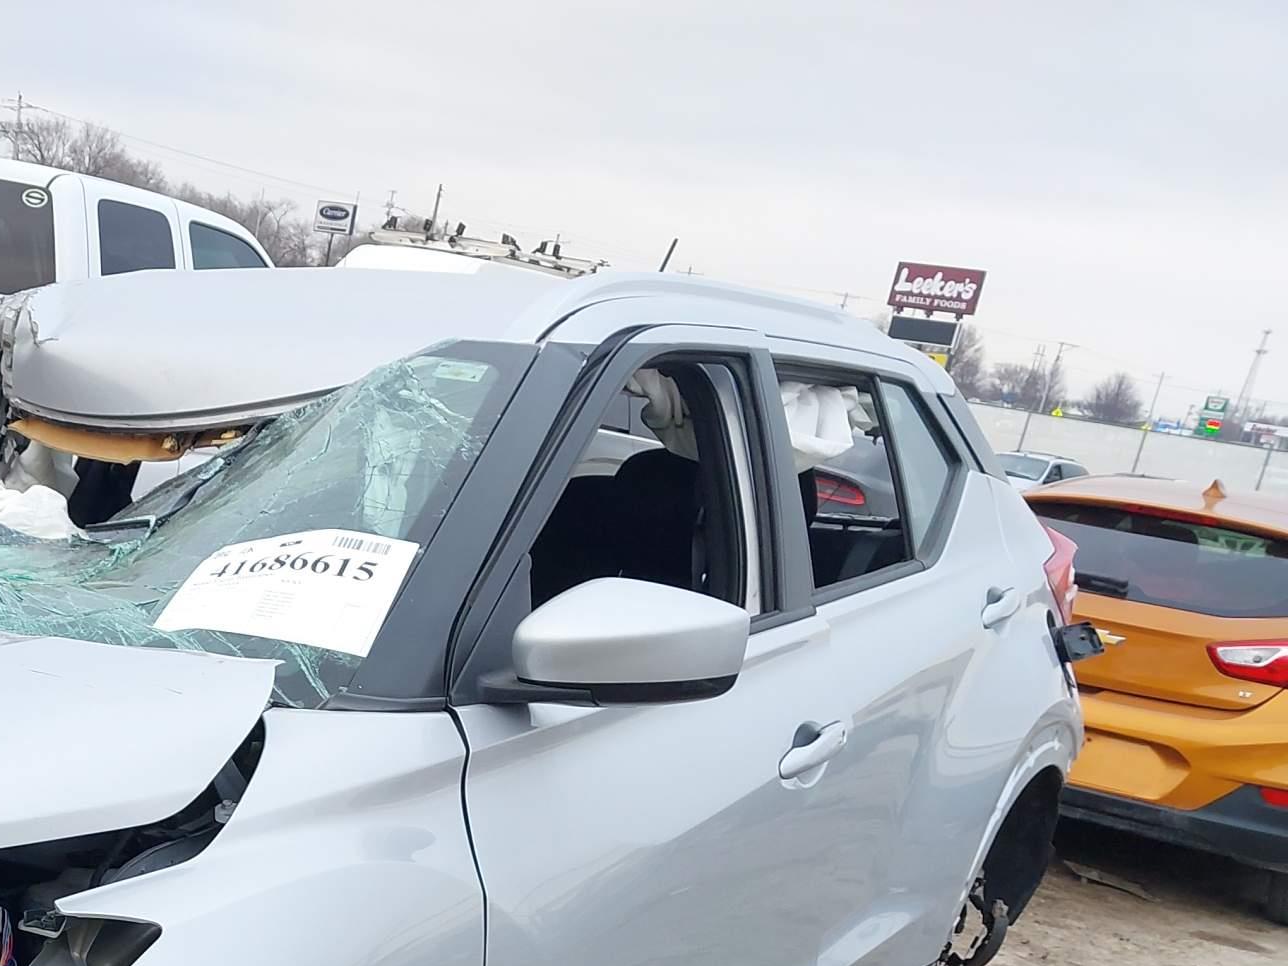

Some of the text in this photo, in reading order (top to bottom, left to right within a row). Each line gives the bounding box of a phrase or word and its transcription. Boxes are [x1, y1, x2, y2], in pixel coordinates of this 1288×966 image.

[894, 267, 977, 300] Leeker's
[895, 294, 967, 310] FAMILY FOODS
[210, 551, 378, 582] 41686615
